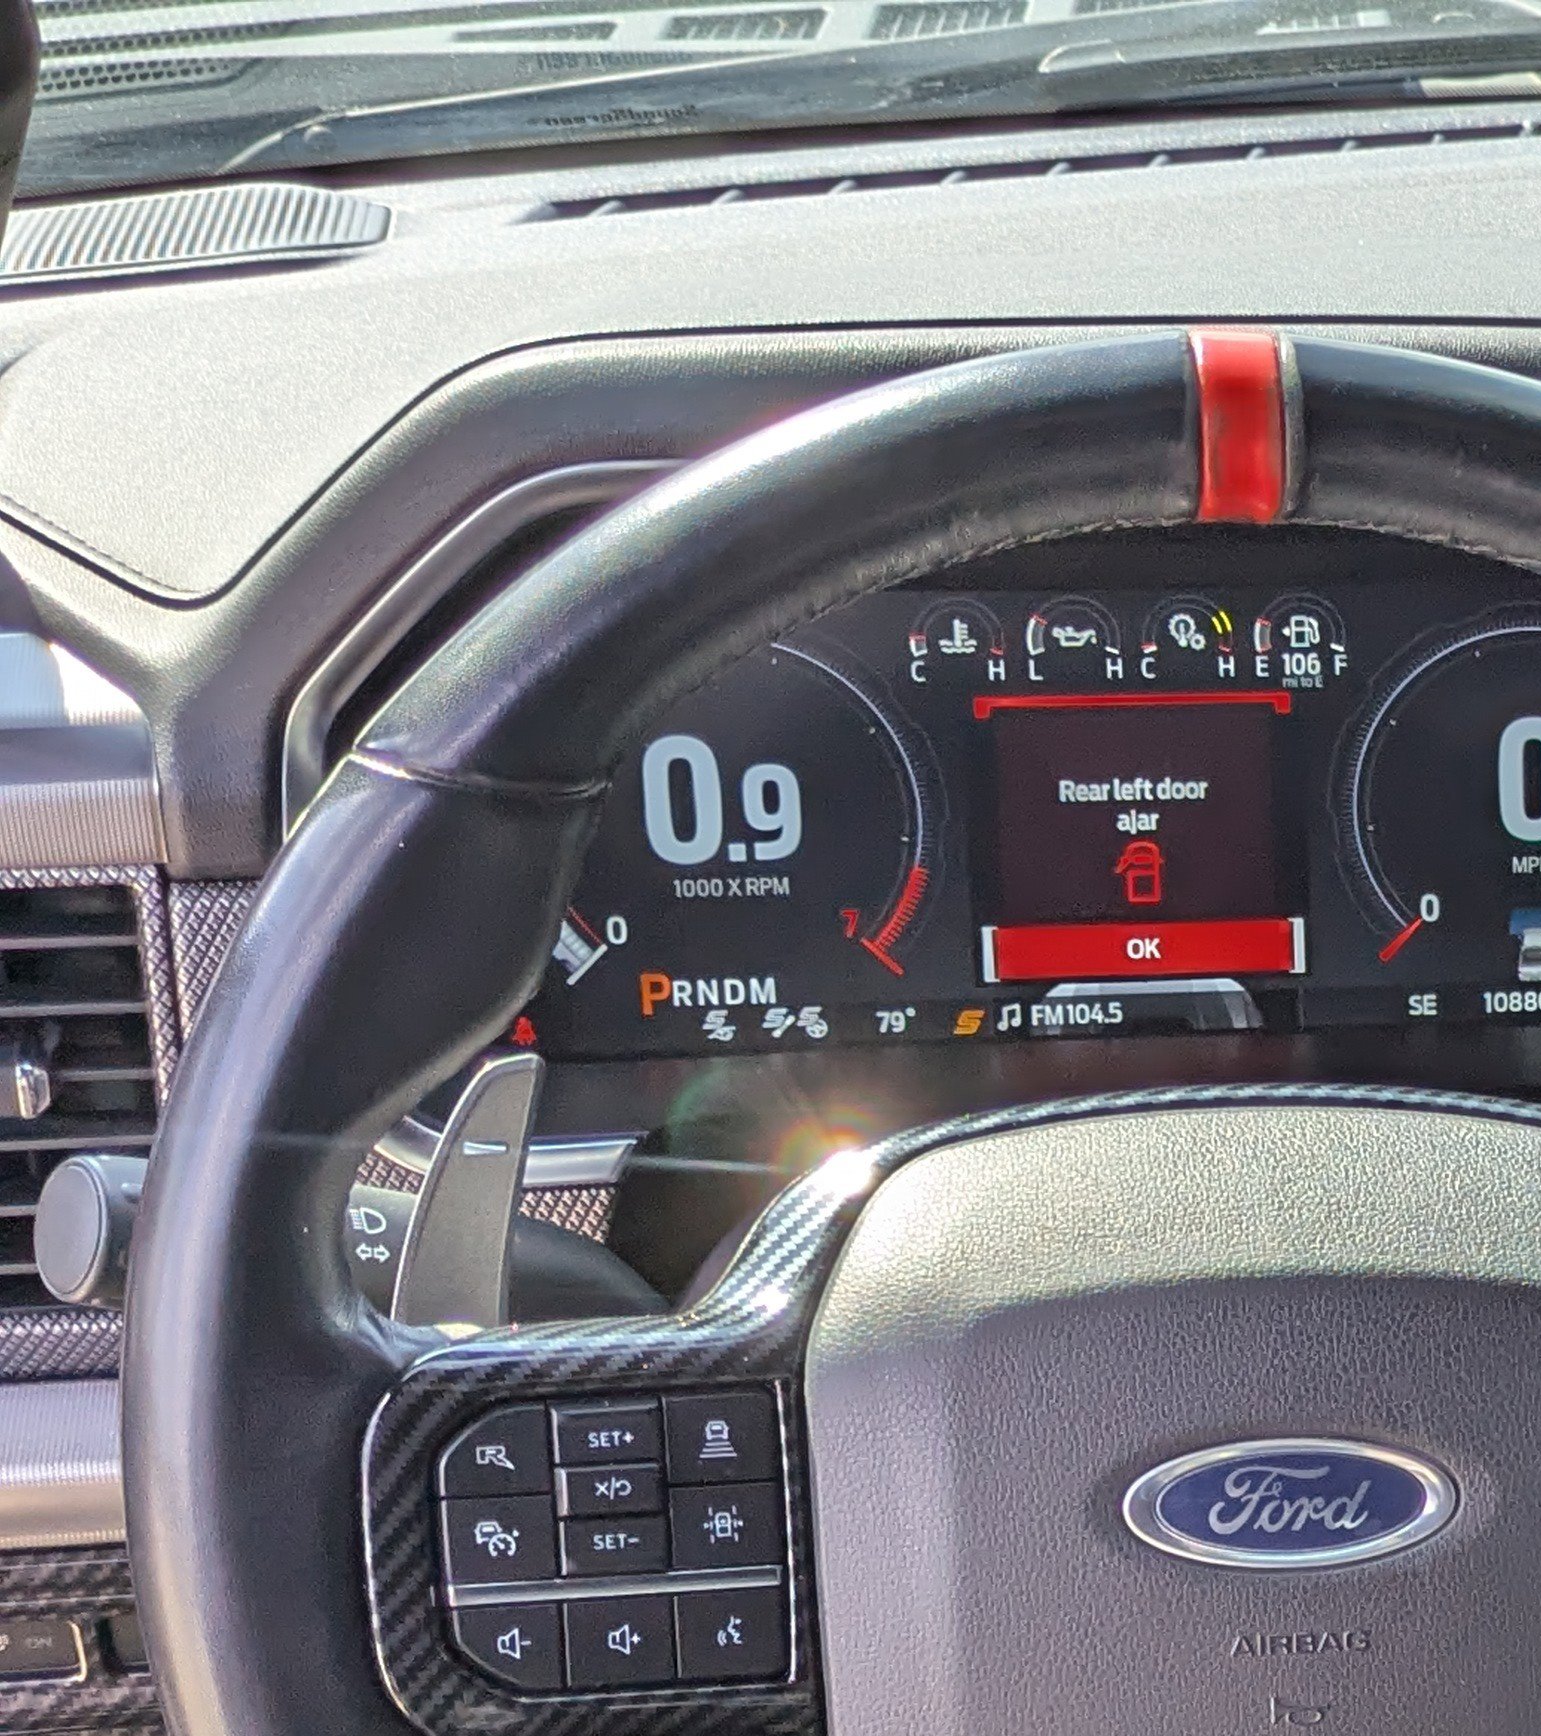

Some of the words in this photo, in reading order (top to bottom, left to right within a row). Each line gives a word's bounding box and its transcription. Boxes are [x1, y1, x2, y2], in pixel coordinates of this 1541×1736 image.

[910, 663, 927, 682] C
[988, 661, 1006, 681] H
[1028, 661, 1044, 681] L
[1105, 659, 1123, 679] H
[1140, 658, 1156, 679] C
[1218, 656, 1235, 677] H
[1255, 655, 1269, 677] E
[1281, 652, 1321, 676] 106
[1334, 654, 1348, 676] F
[641, 734, 802, 866] 0.9
[1058, 780, 1110, 801] Rear
[1114, 778, 1152, 800] left
[1157, 777, 1209, 800] door
[1116, 809, 1160, 834] ajar
[673, 878, 723, 899] 1000
[745, 877, 790, 897] RPM
[1419, 894, 1440, 922] 0
[606, 915, 629, 946] 0
[1127, 938, 1162, 959] OK
[1408, 994, 1438, 1015] SE
[1208, 1464, 1372, 1535] Ford
[1230, 1631, 1371, 1658] AIRBAG
